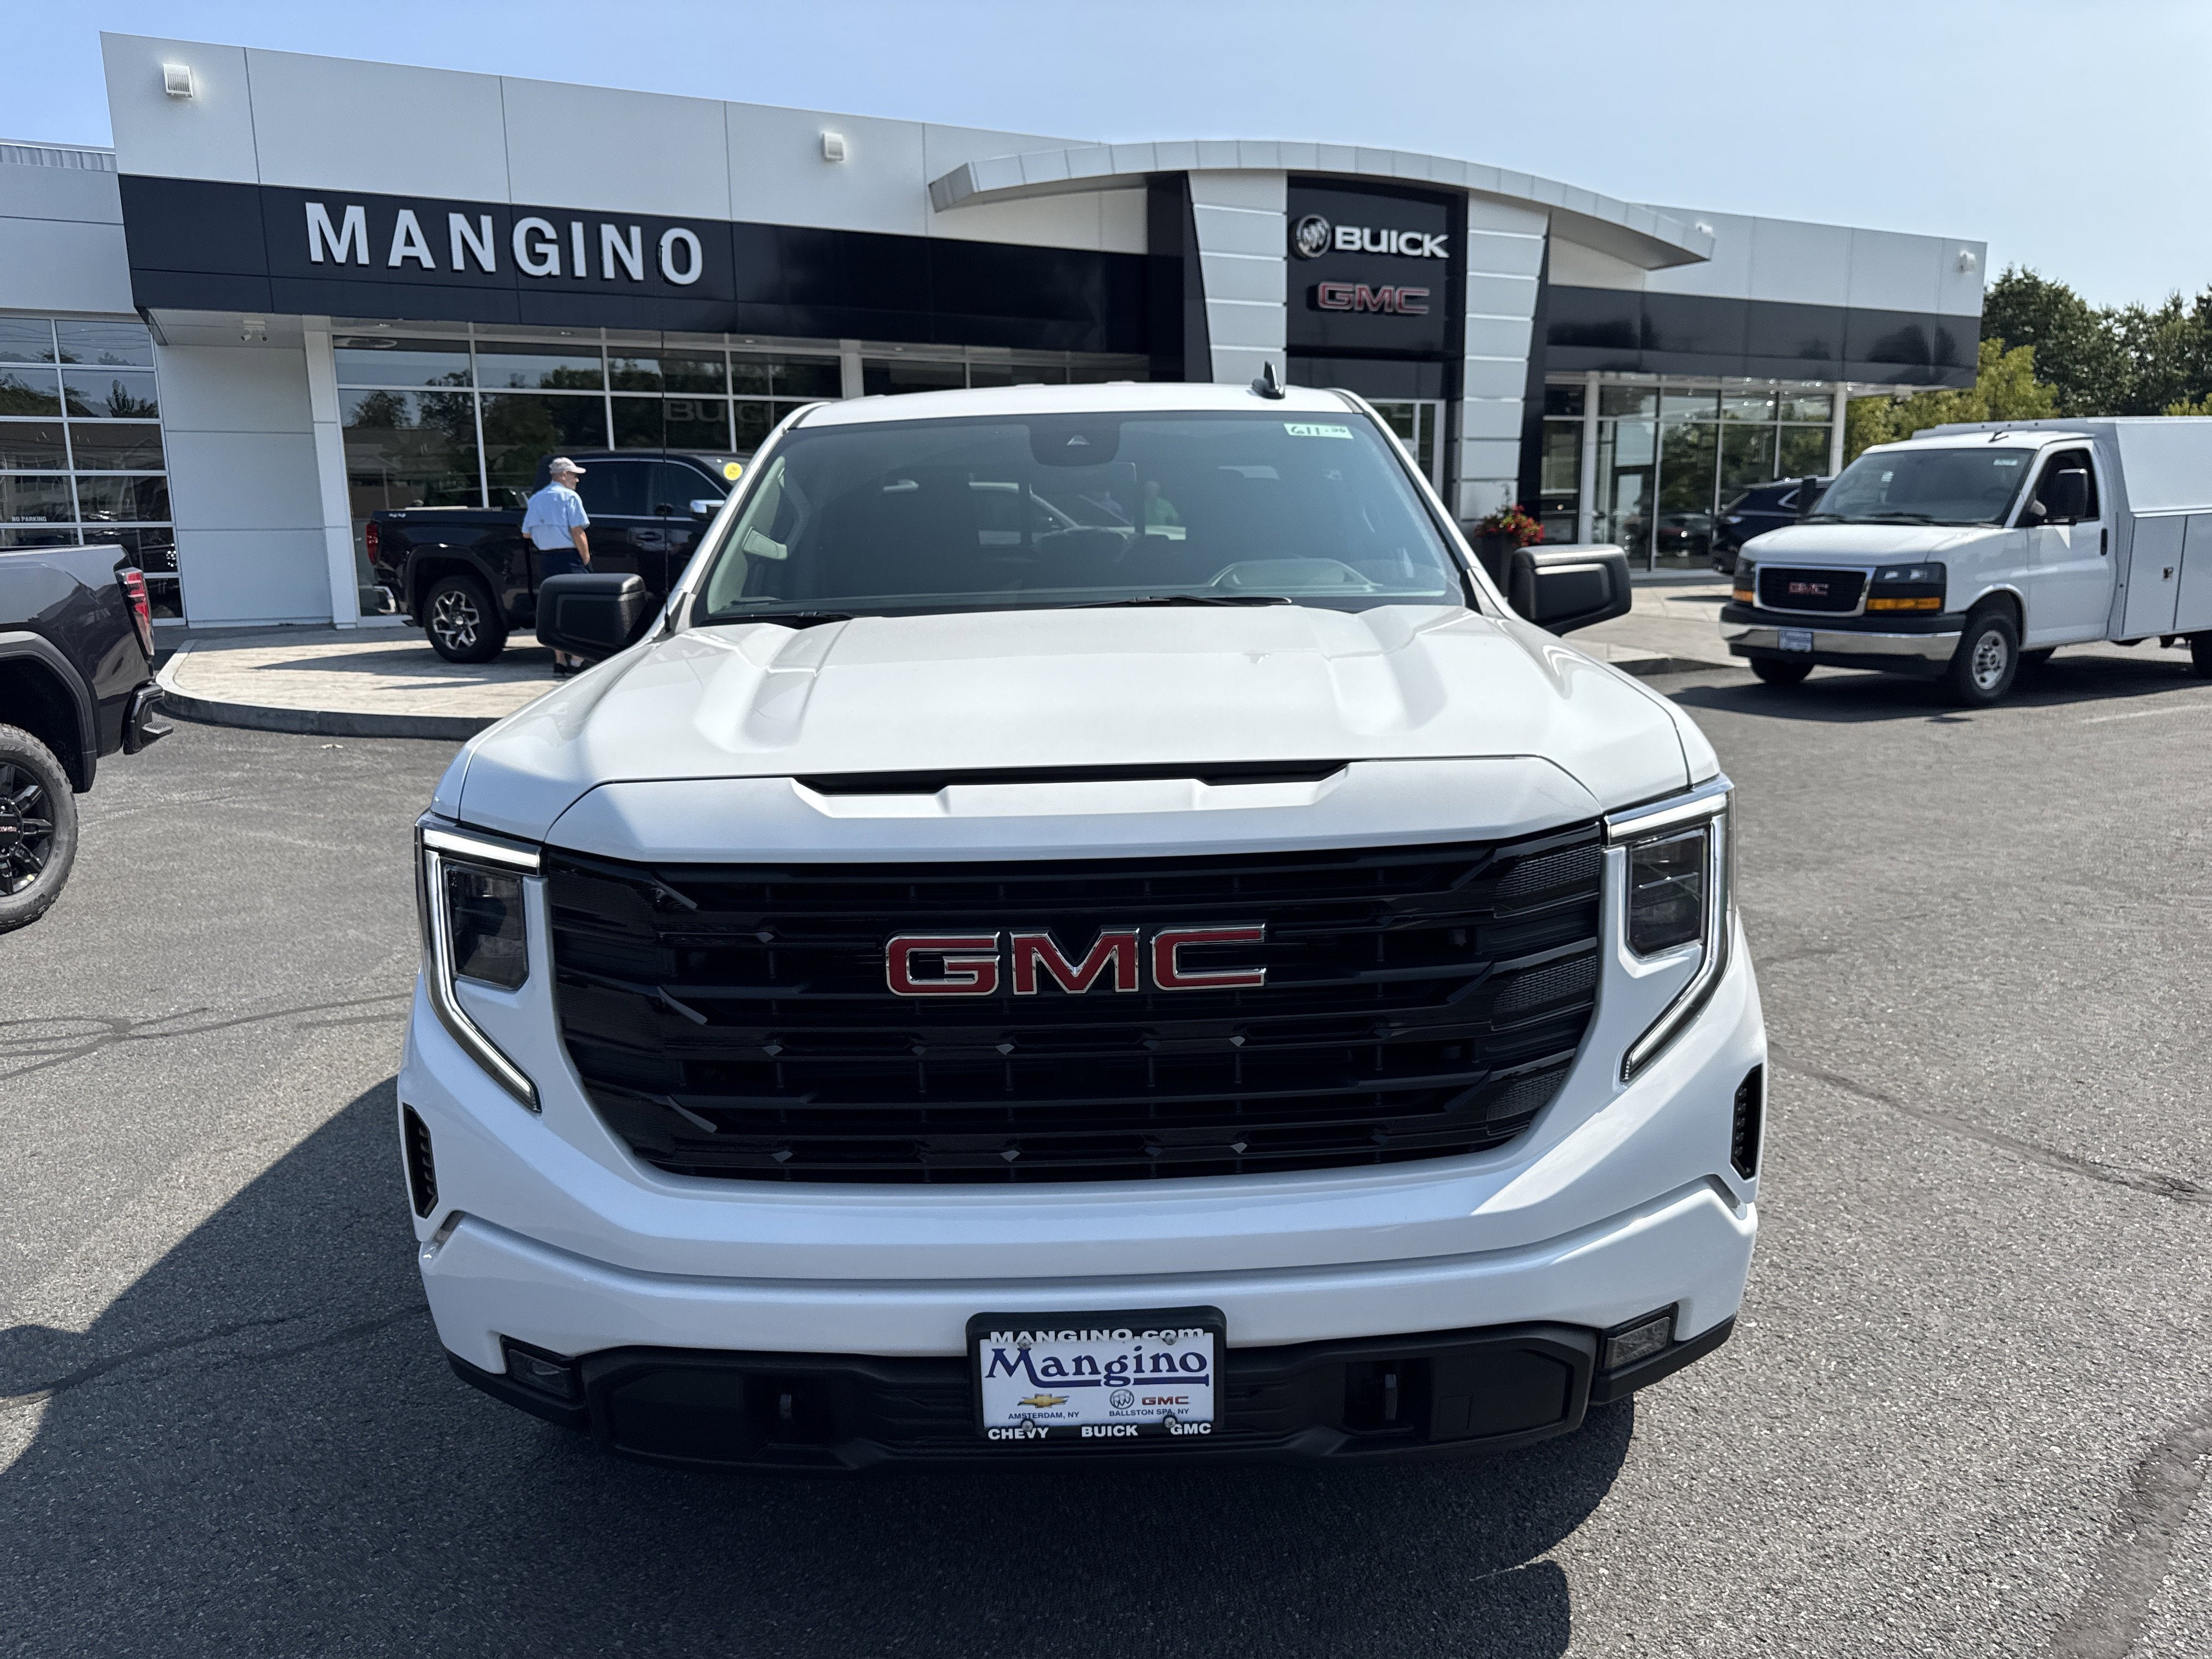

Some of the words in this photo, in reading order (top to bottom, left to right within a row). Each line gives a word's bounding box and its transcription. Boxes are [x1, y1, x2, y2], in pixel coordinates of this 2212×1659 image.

[305, 202, 704, 285] MANGINO
[1334, 225, 1450, 258] BUICK
[1318, 281, 1430, 314] GMC
[1789, 582, 1830, 596] GMC
[885, 923, 1266, 996] GMC
[990, 1328, 1204, 1343] MANGINO.com
[985, 1345, 1209, 1388] Mangino
[1142, 1396, 1190, 1406] GMC
[988, 1427, 1049, 1440] CHEVY
[1081, 1425, 1138, 1437] BUICK
[1170, 1423, 1211, 1435] GMC
